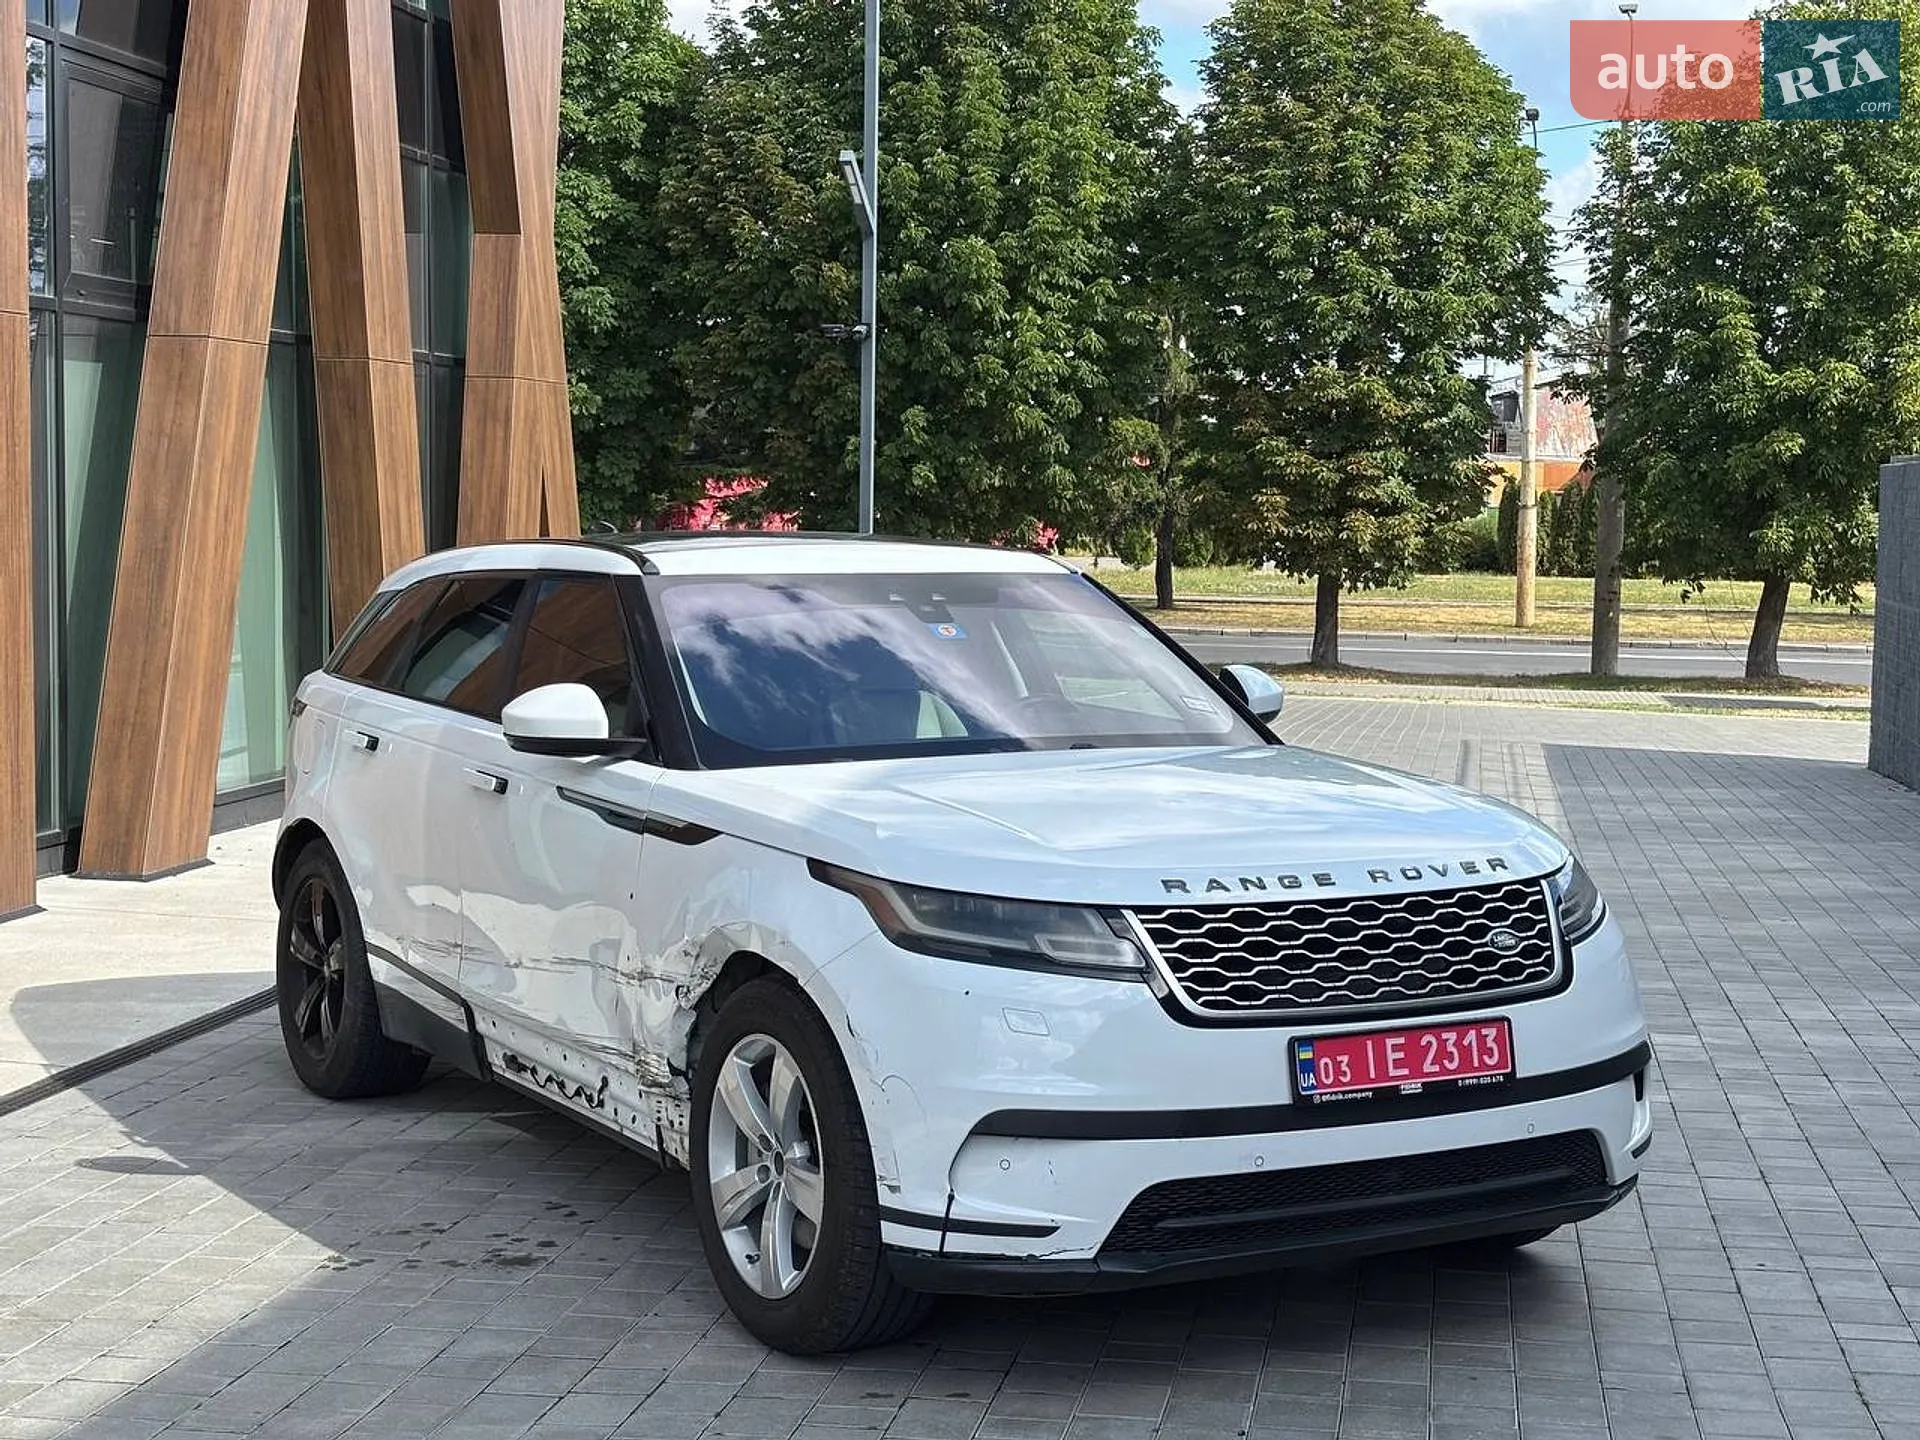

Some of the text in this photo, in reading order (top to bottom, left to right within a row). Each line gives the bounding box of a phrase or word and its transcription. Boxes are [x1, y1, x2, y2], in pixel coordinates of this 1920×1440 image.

[1160, 857, 1510, 894] RANGE ROVER
[1318, 1027, 1500, 1085] 03 IE 2313
[1300, 1073, 1317, 1088] UA
